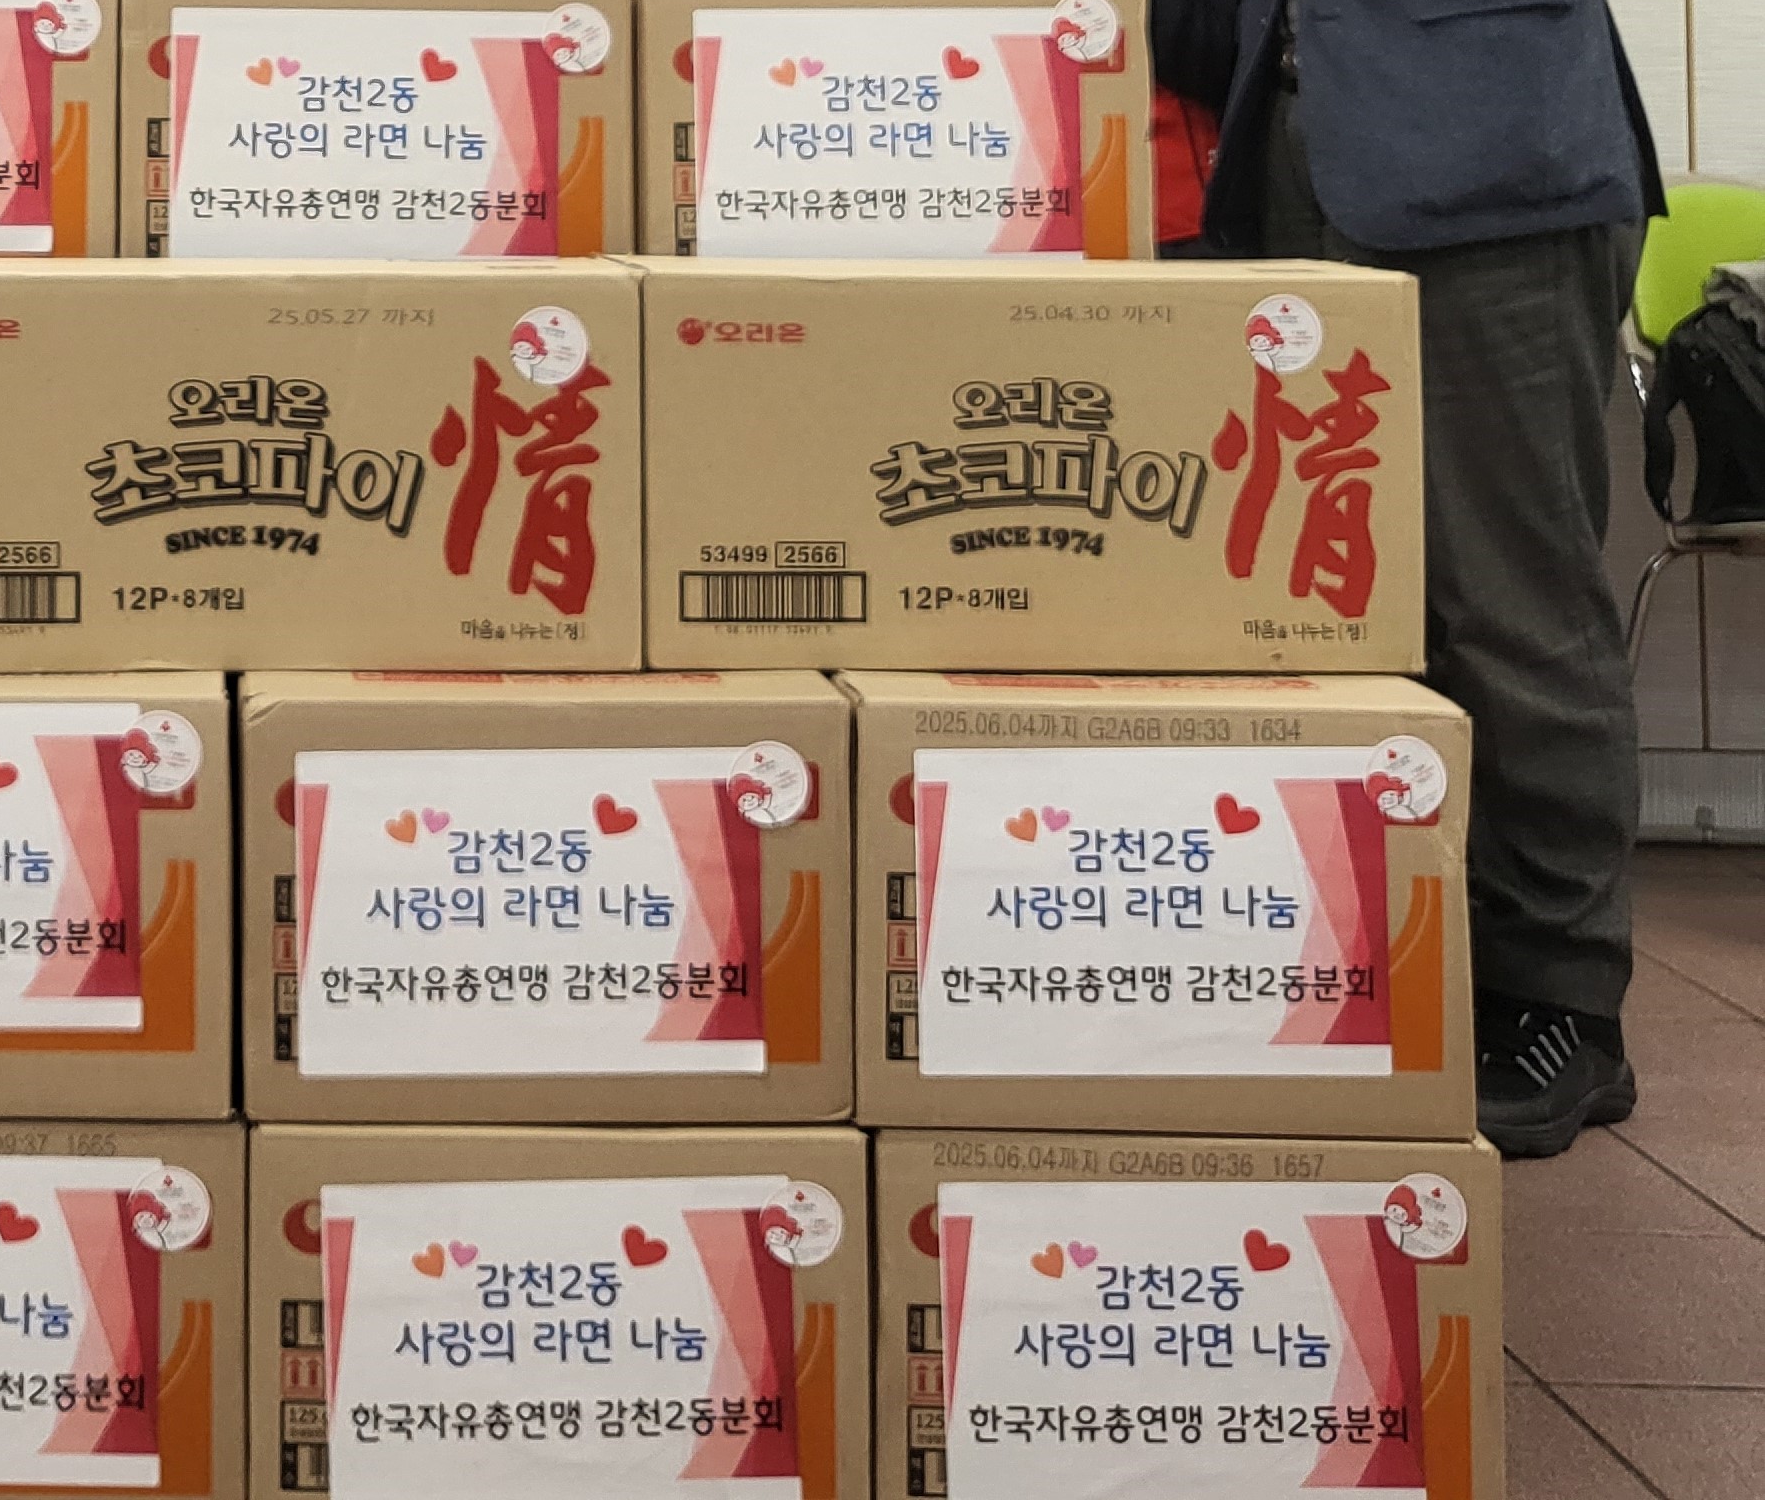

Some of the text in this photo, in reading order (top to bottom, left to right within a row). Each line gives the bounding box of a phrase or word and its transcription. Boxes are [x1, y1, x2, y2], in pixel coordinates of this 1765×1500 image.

[298, 75, 418, 113] 감천2동
[822, 74, 941, 112] 감천2동
[228, 123, 487, 160] 사랑의 라면 나눔
[754, 122, 1011, 160] 사랑의 라면 나눔
[189, 186, 547, 220] 한국자유총연맹 감천2동분회
[716, 186, 1071, 221] 한국자유총연맹 감천2동분회
[267, 306, 435, 329] 25.05.27 까지
[713, 321, 807, 345] 오리온
[1008, 304, 1175, 326] 25.04.30 까지
[167, 374, 330, 431] 오리온
[951, 376, 1116, 432] 오리온
[84, 432, 426, 538] 초코파이
[430, 355, 612, 616] 情
[869, 433, 1209, 539] 초코파이
[1211, 345, 1393, 619] 情
[165, 524, 322, 558] SINCE 1974
[700, 545, 838, 564] 53499 2566
[950, 525, 1106, 558] SINCE 1974
[448, 828, 592, 875] 감천2동
[1069, 828, 1214, 874] 감천2동
[367, 884, 675, 930] 사랑의 라면 나눔
[987, 885, 1299, 930] 사랑의 라면 나눔
[321, 961, 748, 1003] 한국자유총연맹 감천2동분회
[941, 964, 1375, 1004] 한국자유총연맹 감천2동분회
[1271, 1152, 1325, 1179] 1657
[477, 1261, 622, 1308] 감천2동
[1096, 1264, 1244, 1312] 감천2동
[395, 1317, 707, 1366] 사랑의 라면 나눔
[1014, 1323, 1332, 1370] 사랑의 라면 나눔
[351, 1396, 784, 1443] 한국자유총연맹 감천2동분회
[968, 1404, 1410, 1445] 한국자유총연맹 감천2동분회
